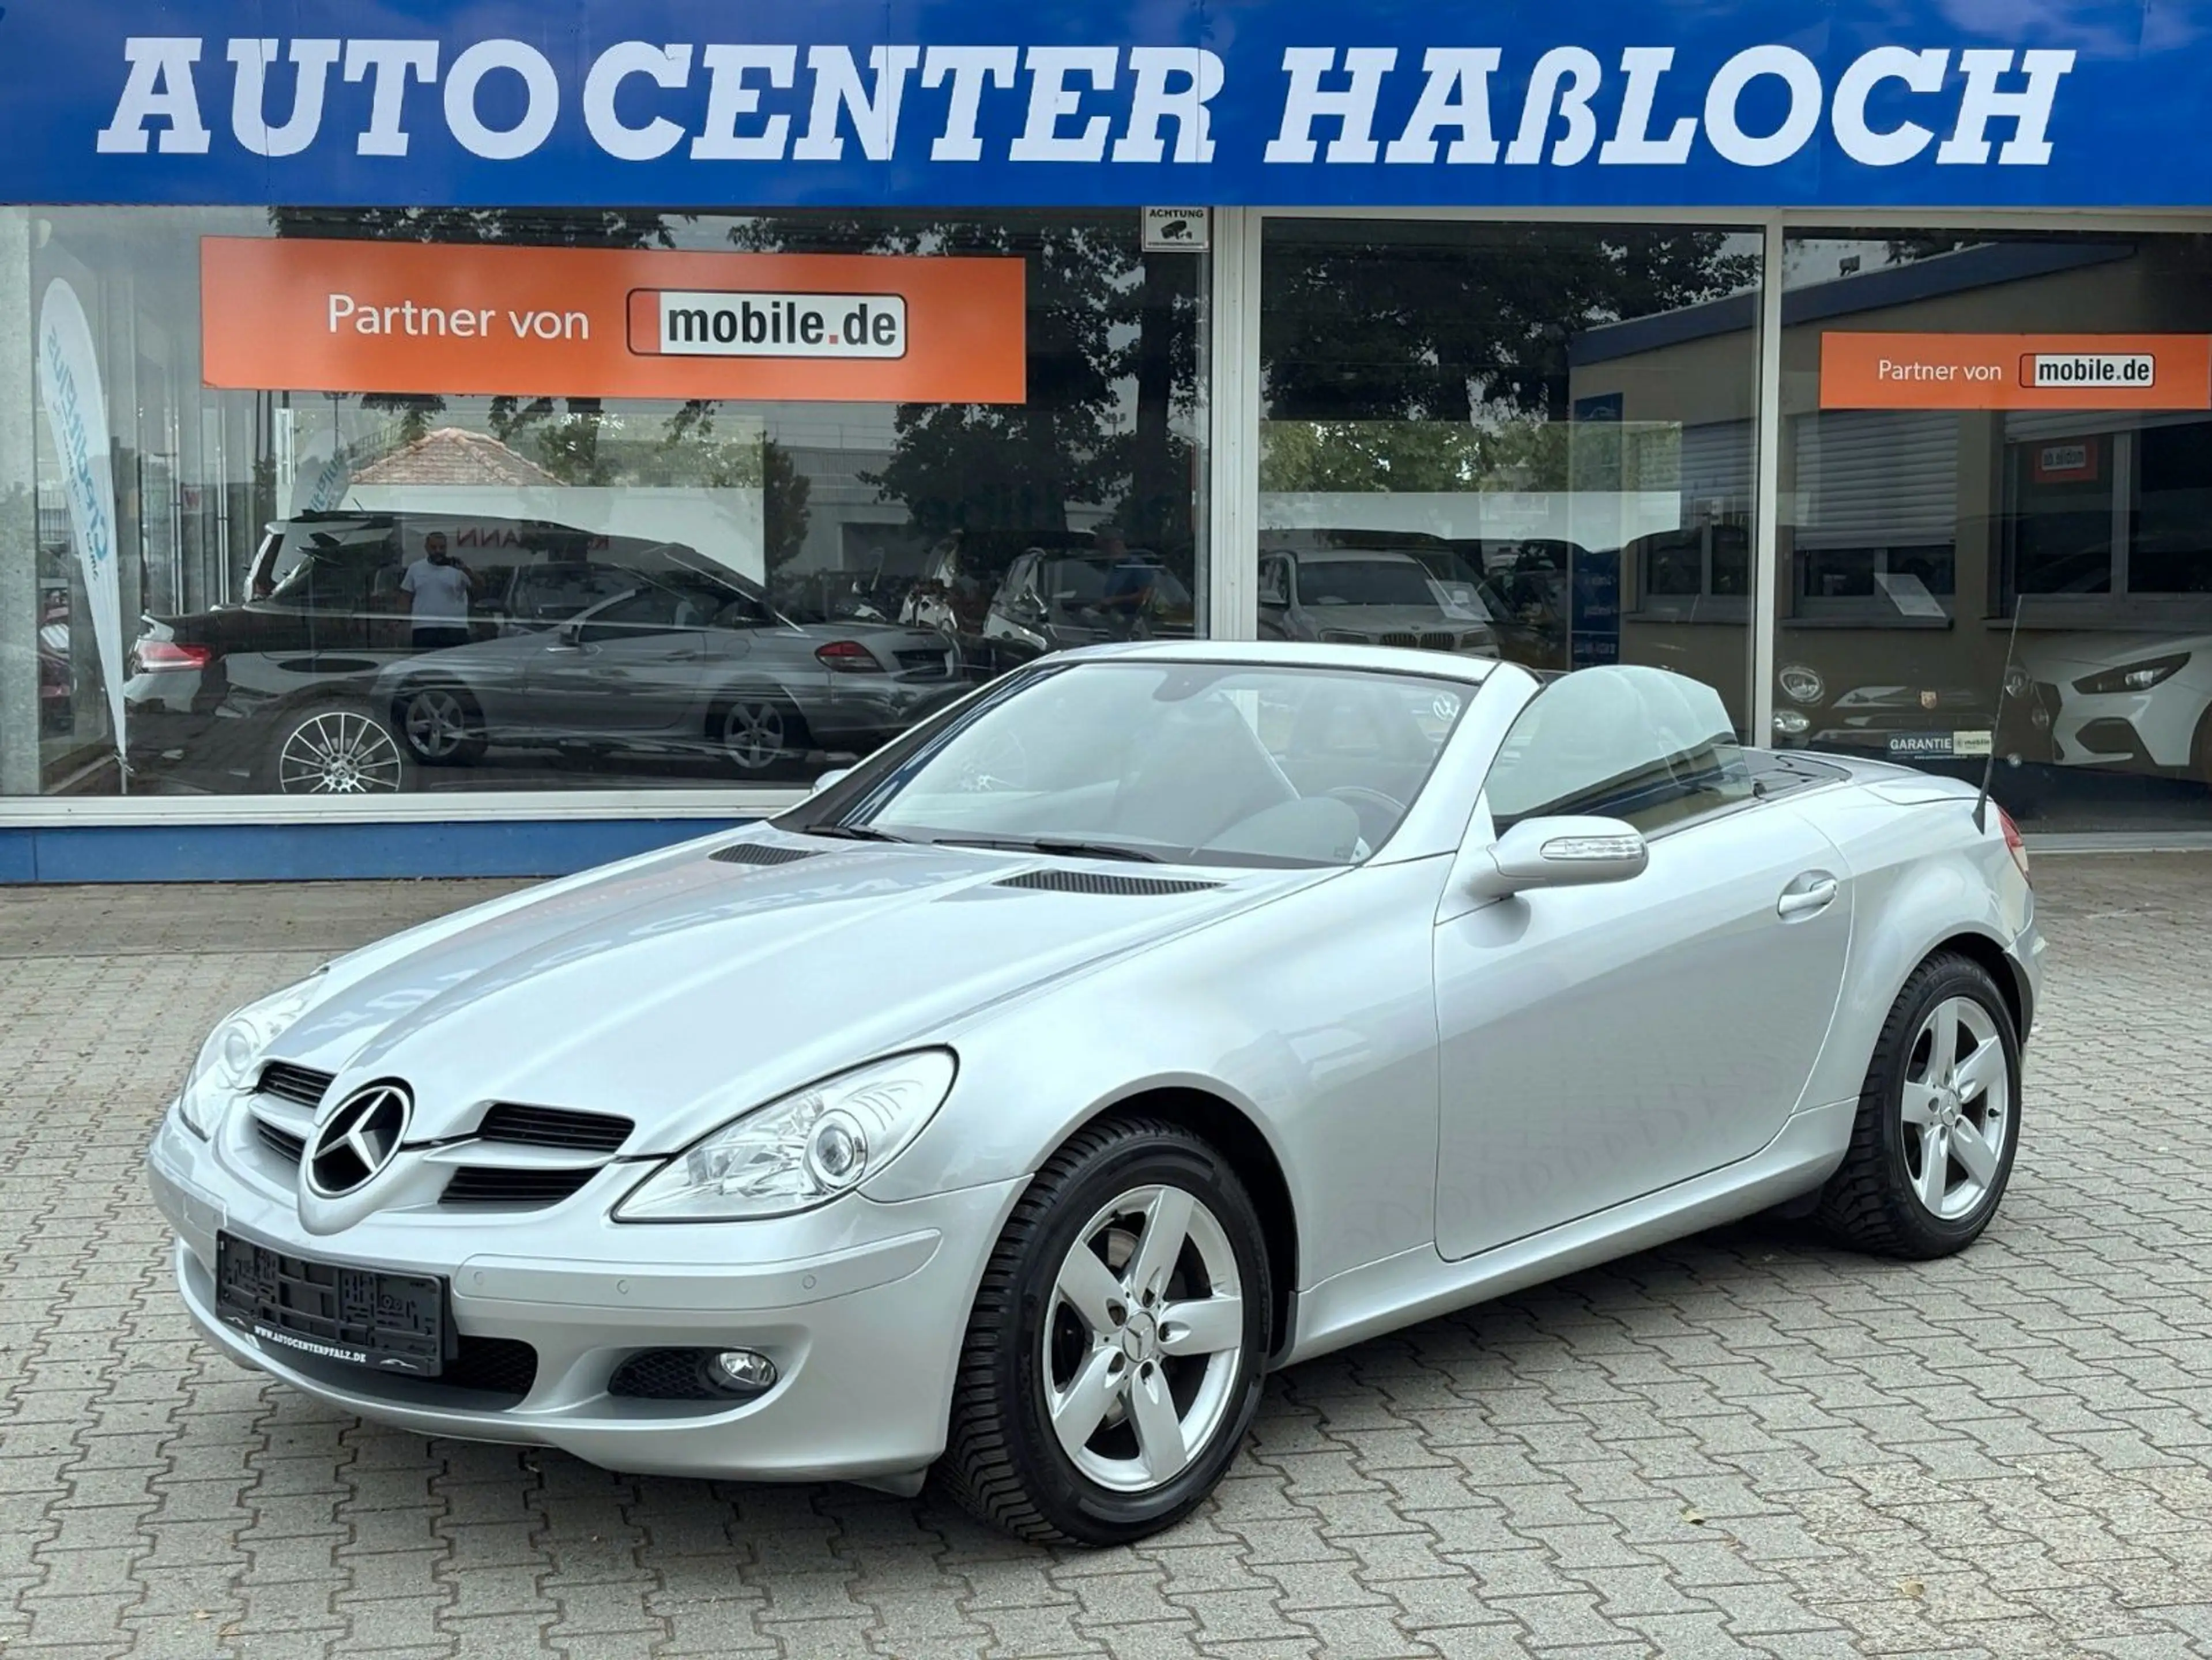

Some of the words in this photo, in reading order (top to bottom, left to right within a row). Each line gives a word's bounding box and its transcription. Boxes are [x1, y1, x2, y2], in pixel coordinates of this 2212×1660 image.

[1264, 45, 2075, 166] HAßLOCH
[1150, 209, 1204, 218] ACHTUNG
[329, 294, 496, 337] Partner
[508, 311, 589, 339] von
[669, 301, 896, 346] mobile.de
[1879, 359, 1958, 380] Partner
[1964, 365, 2002, 380] von
[2038, 359, 2150, 381] mobile.de
[1890, 738, 1952, 750] GARANTIE
